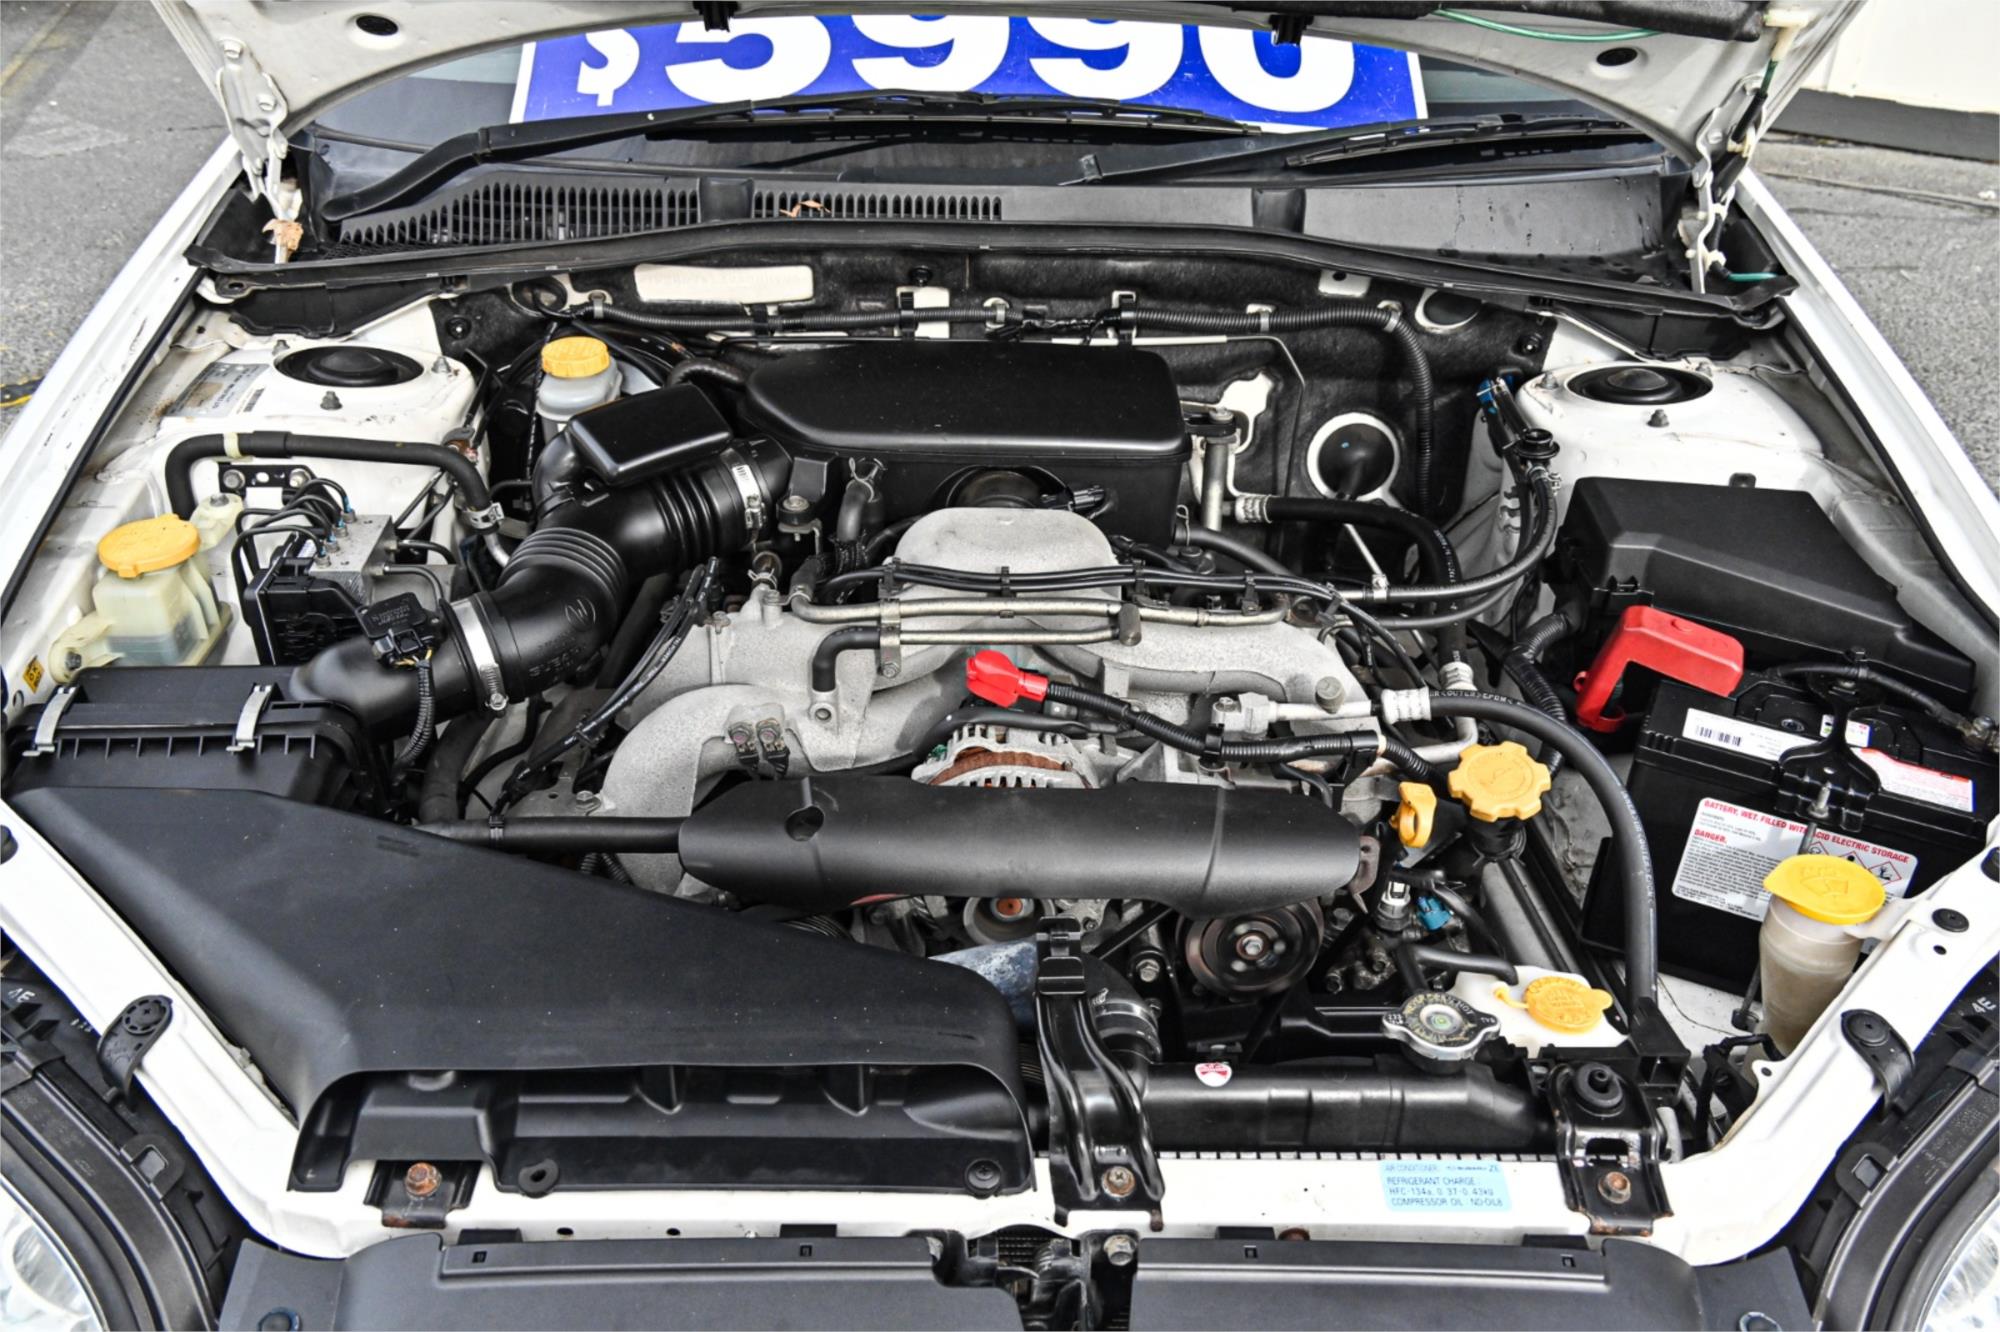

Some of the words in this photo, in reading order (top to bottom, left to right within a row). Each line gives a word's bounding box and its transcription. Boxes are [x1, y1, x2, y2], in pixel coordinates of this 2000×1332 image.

[1760, 815, 1787, 828] FILLED
[1832, 836, 1870, 852] ELECTRIC
[1871, 846, 1909, 864] STORAGE
[1386, 1176, 1440, 1185] REFRIGERANT
[1391, 1197, 1447, 1207] COMPRESSOR
